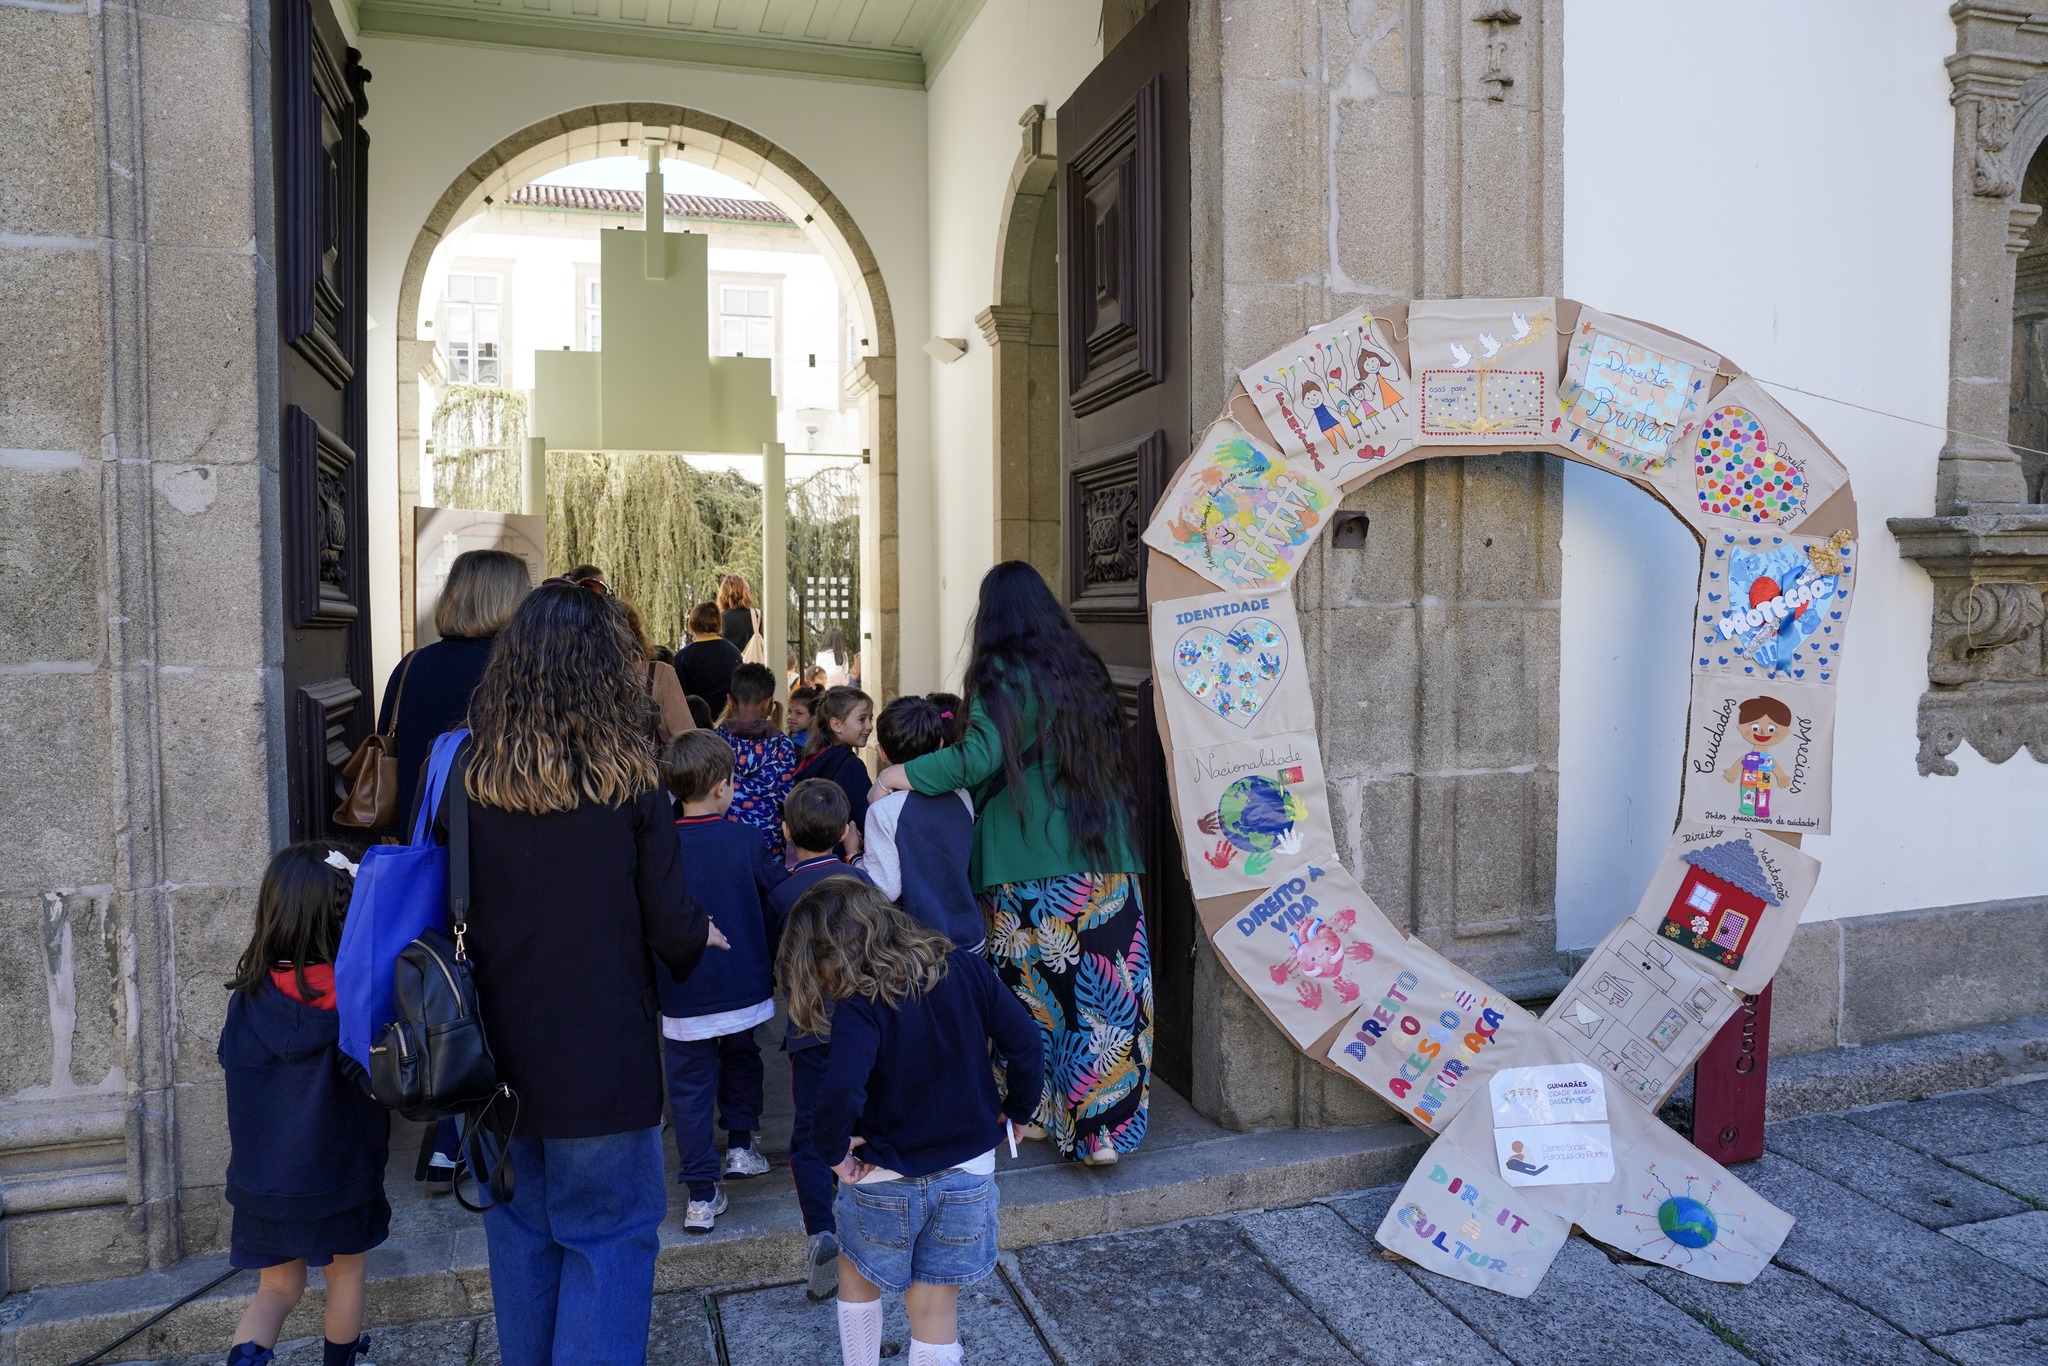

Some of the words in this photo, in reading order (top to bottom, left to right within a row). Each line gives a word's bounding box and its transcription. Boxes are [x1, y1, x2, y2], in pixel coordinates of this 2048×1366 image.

[1606, 350, 1673, 388] Direito
[1586, 387, 1673, 444] Brincar
[1774, 442, 1806, 473] Direito
[1176, 598, 1270, 626] IDENTIDADE
[1694, 698, 1737, 774] Cuidados
[1789, 716, 1812, 794] especiais
[1193, 743, 1303, 783] Nacionalidade
[1775, 815, 1785, 825] de
[1682, 826, 1724, 843] Direito
[1758, 847, 1789, 901] Habitação
[1236, 877, 1306, 937] DIREITO
[1270, 895, 1319, 933] VIDA
[1344, 970, 1419, 1062] DIREITO
[1391, 1015, 1421, 1053] AO
[1389, 1009, 1461, 1099] ACESSO
[1547, 1080, 1588, 1090] GUIMARÃES
[1548, 1089, 1572, 1098] CIDADE
[1572, 1088, 1596, 1096] AMIGA
[1541, 1144, 1566, 1153] Centro
[1566, 1142, 1586, 1152] Social
[1543, 1152, 1575, 1162] Paroquial
[1575, 1151, 1585, 1159] de
